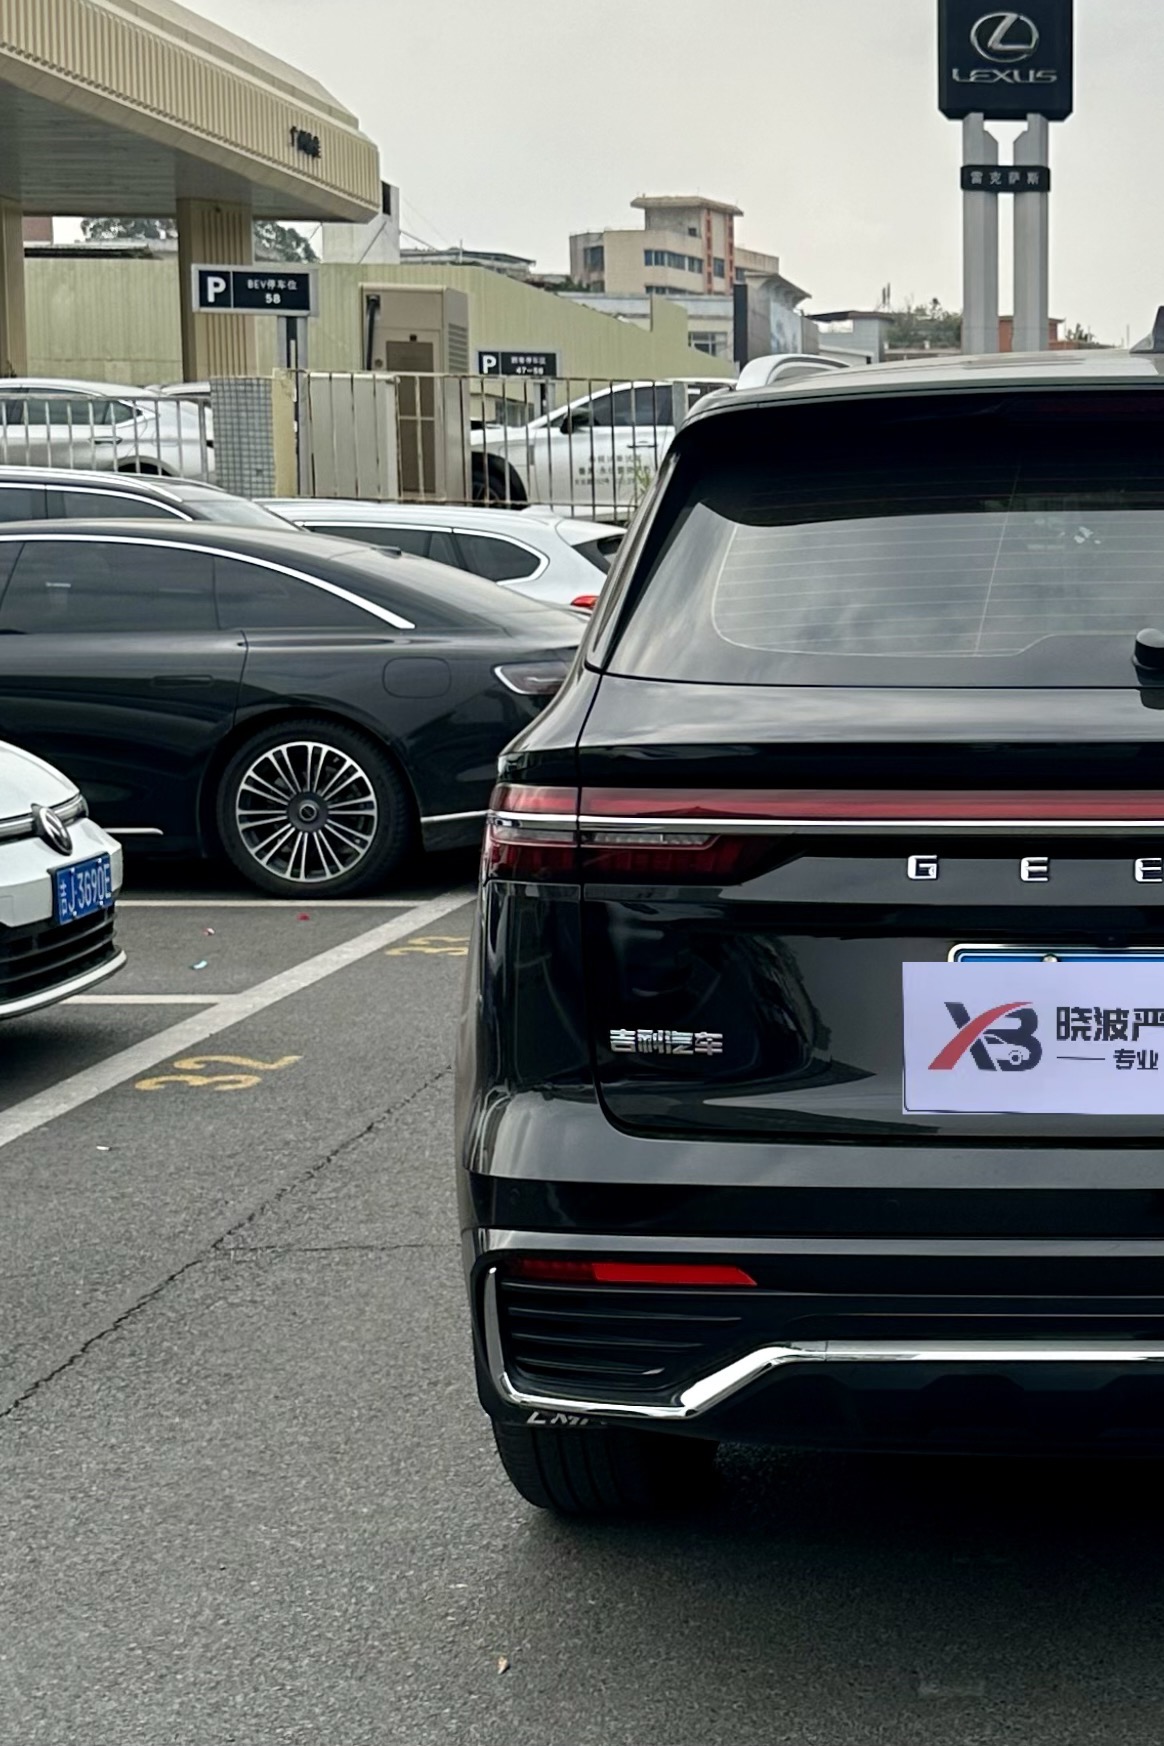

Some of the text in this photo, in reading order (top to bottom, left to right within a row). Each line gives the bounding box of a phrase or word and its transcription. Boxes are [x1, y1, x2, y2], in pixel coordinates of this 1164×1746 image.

[952, 68, 1057, 84] LEXUS
[970, 171, 1040, 186] 雷克萨斯
[207, 276, 226, 303] P
[265, 293, 281, 304] 58
[482, 354, 497, 374] P
[609, 1028, 723, 1056] 吉利汽车
